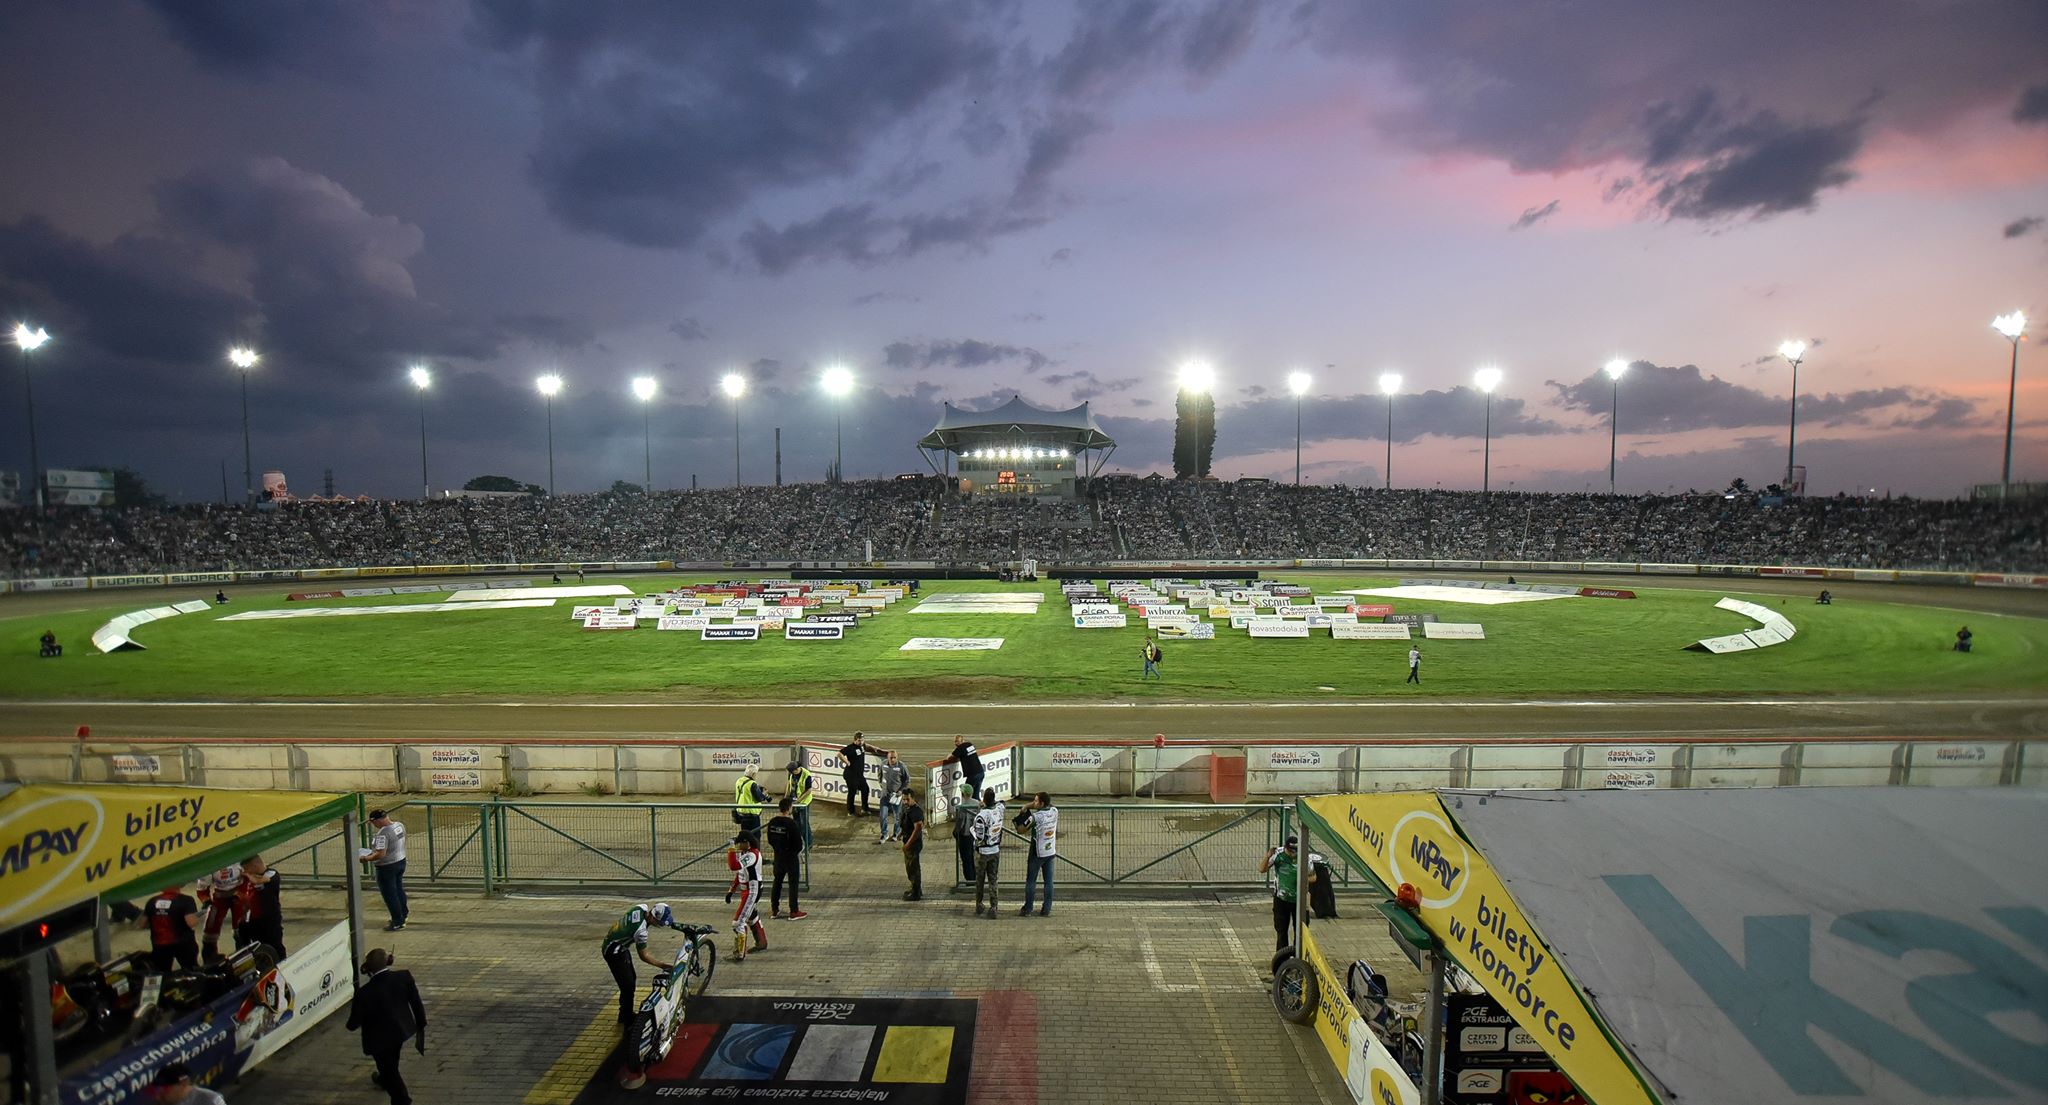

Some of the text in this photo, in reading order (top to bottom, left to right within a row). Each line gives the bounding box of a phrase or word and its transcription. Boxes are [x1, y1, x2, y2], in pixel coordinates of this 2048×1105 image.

[1147, 606, 1185, 615] wyborcza
[1250, 624, 1307, 633] novastodola.pl
[432, 755, 480, 763] nawymiar.pl
[1052, 751, 1078, 759] daszki
[1271, 751, 1297, 759] daszki
[1608, 755, 1656, 763] nawymiar.pl
[712, 757, 761, 765] nawymiar.pl
[1052, 757, 1102, 766] nawymiar.pl
[1271, 757, 1321, 766] nawymiar.pl
[432, 778, 480, 786] nawymiar.pl
[125, 795, 204, 837] bilety
[1349, 803, 1385, 859] Kupuj
[85, 811, 240, 882] w komórce
[1410, 834, 1462, 891] MPAY
[1476, 895, 1544, 976] bilety
[1449, 915, 1577, 1052] w komórce
[300, 990, 330, 1015] GRUPA
[773, 1002, 857, 1012] EKSTRALIGA
[805, 1009, 853, 1020] PGE
[1461, 1006, 1489, 1016] PGE
[1460, 1014, 1513, 1025] EKSTRALIGA
[78, 1021, 213, 1102] Częstochowska
[1467, 1080, 1490, 1088] PGE
[655, 1086, 709, 1097] świata
[710, 1086, 740, 1097] liga
[811, 1088, 890, 1102] Najlepsza
